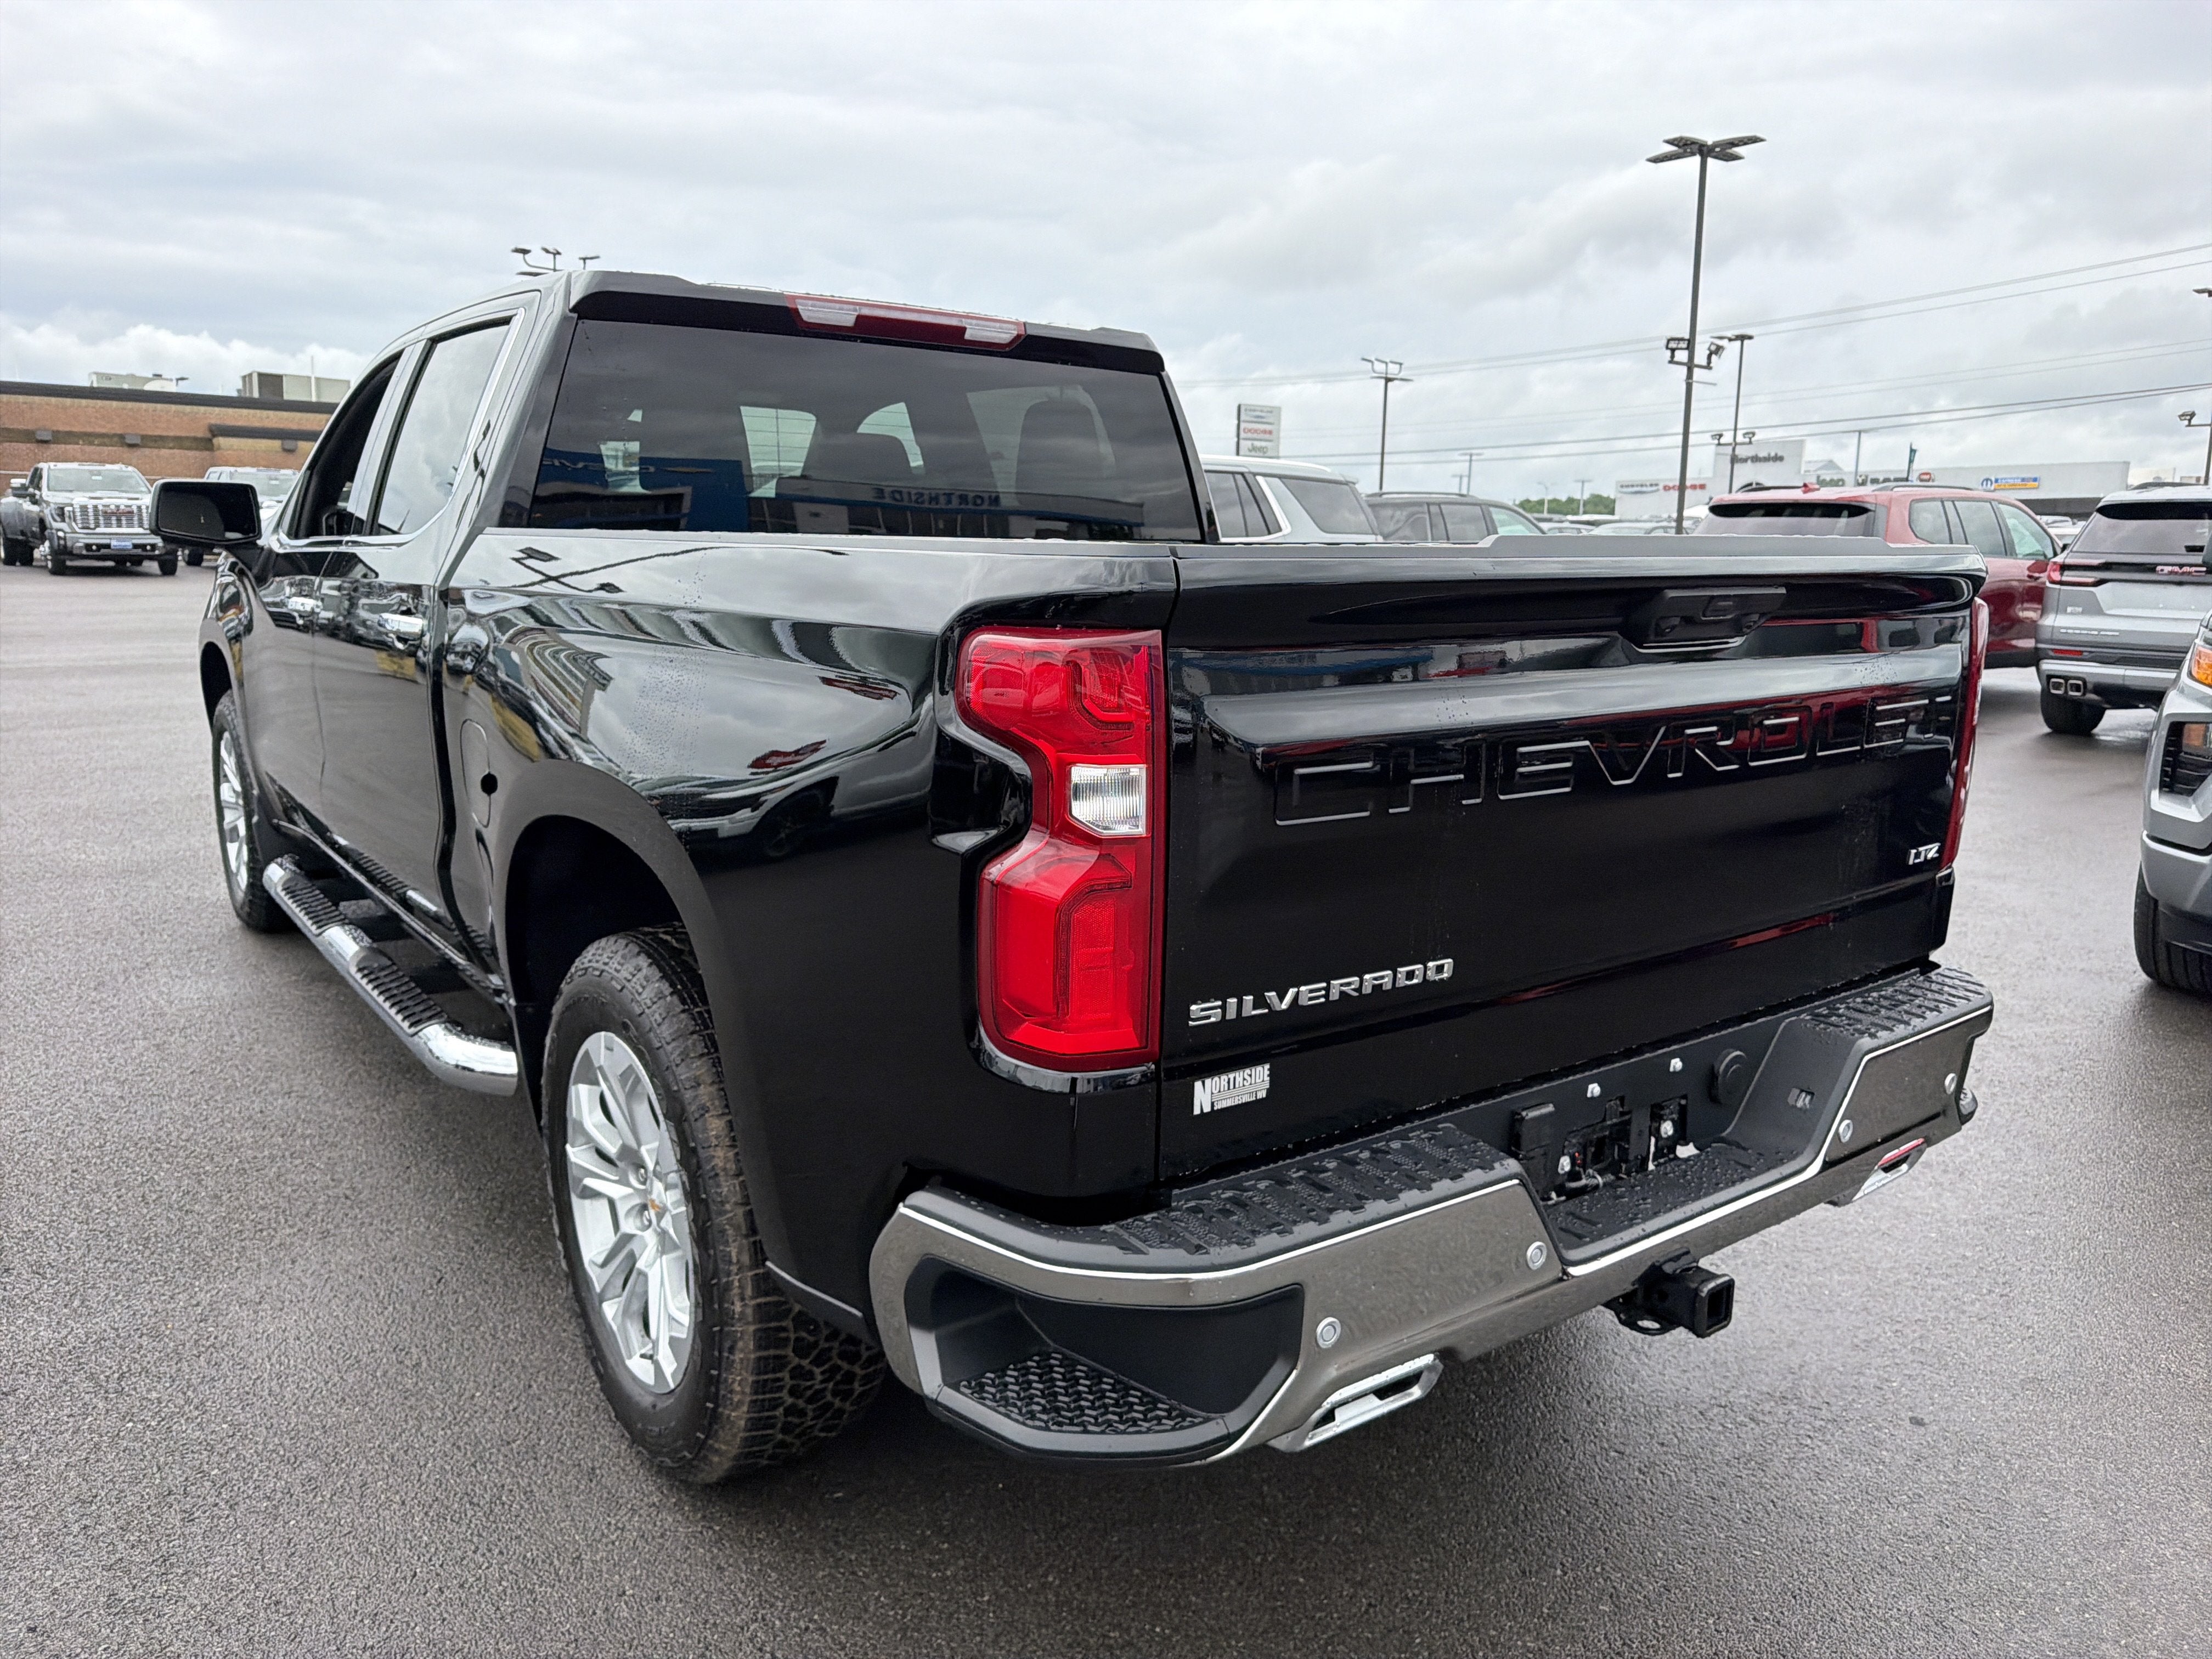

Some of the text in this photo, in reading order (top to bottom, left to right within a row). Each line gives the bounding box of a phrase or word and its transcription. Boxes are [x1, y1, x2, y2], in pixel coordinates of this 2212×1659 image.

[2156, 565, 2207, 575] GMC
[1274, 695, 1953, 826] CHEVROLET
[1906, 842, 1941, 865] LTZ
[1188, 958, 1454, 1026] SILVERADO
[1193, 1063, 1271, 1115] NORTHSIDE
[1214, 1088, 1267, 1110] SUMMERSVILLE WV
